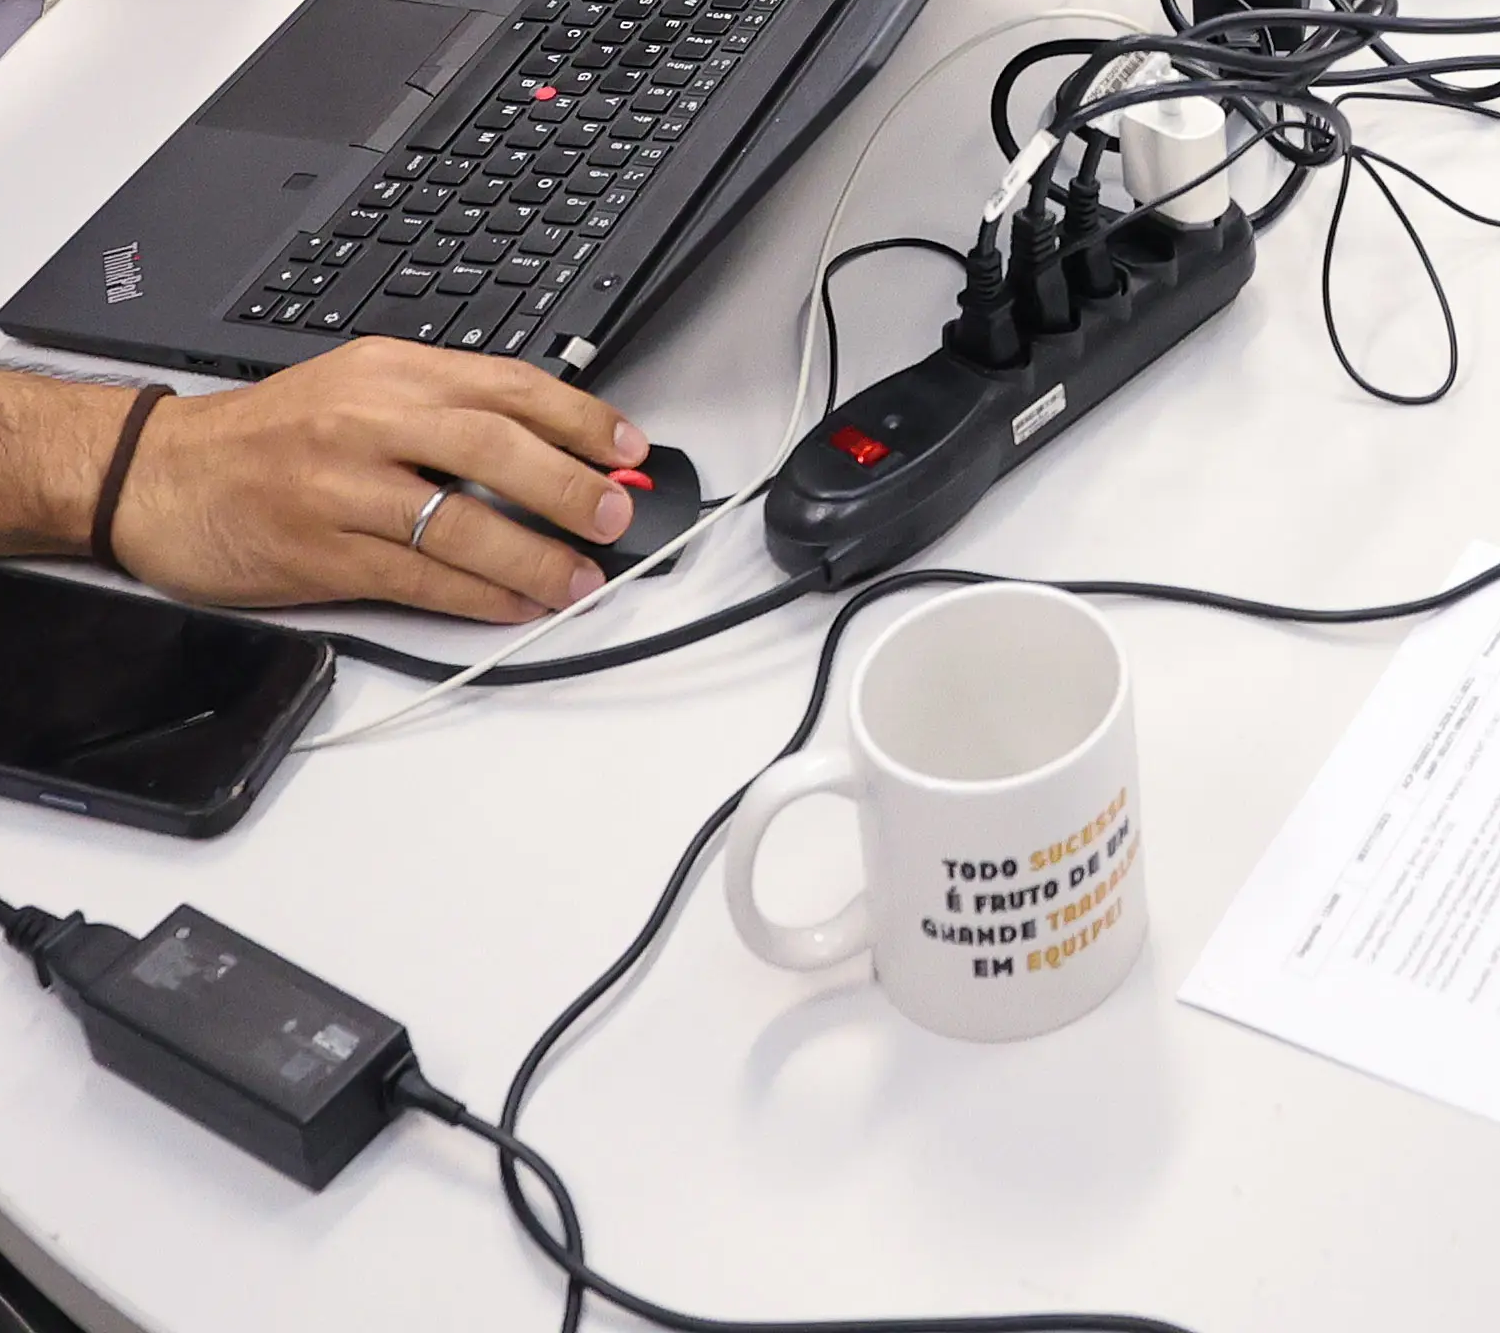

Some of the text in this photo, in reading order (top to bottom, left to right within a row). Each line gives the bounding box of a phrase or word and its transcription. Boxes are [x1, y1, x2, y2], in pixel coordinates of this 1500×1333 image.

[102, 240, 143, 304] ThinkPad
[942, 858, 1018, 882] TODO
[945, 814, 1130, 914] É FRUTO DE UM
[921, 918, 1037, 947] GRANDE
[972, 896, 1125, 978] EM EQUIPE!
